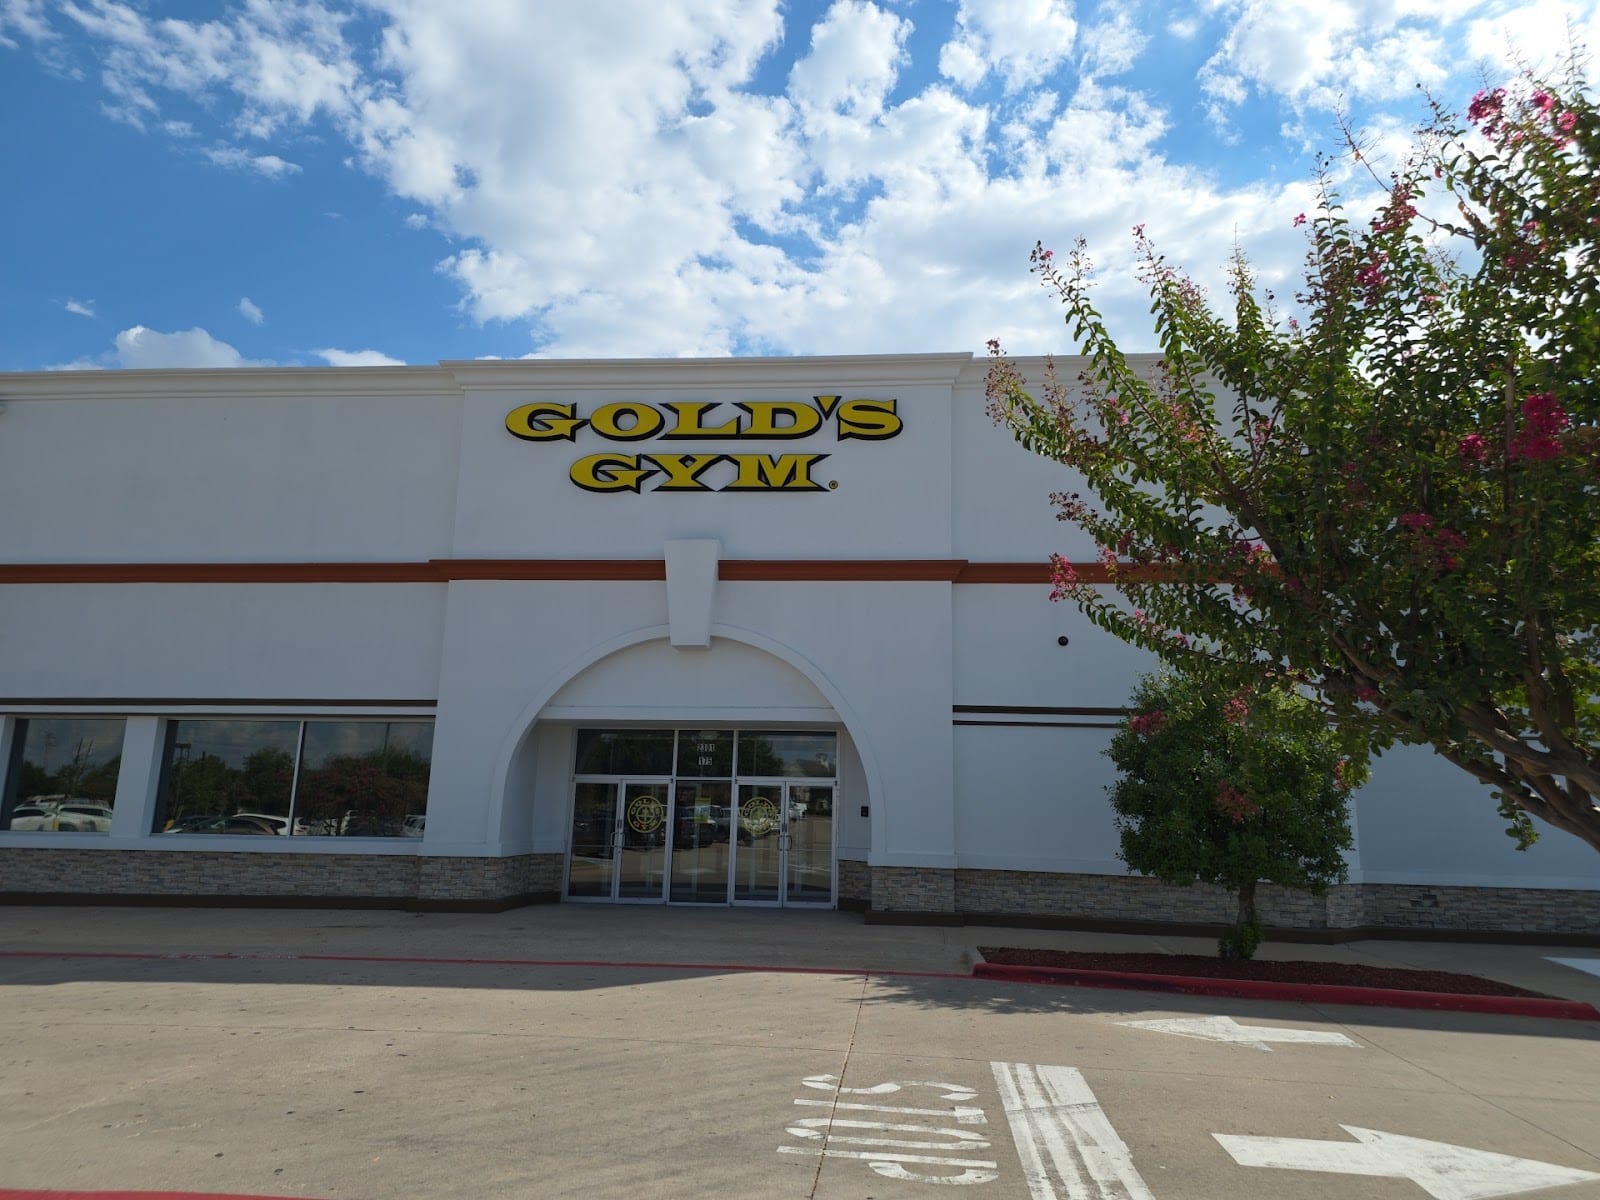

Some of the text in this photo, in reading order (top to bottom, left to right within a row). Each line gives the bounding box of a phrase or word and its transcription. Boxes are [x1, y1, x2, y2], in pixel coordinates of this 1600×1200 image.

[505, 396, 903, 442] GOLD'S
[569, 453, 832, 494] GYM
[776, 1073, 999, 1186] STOP
